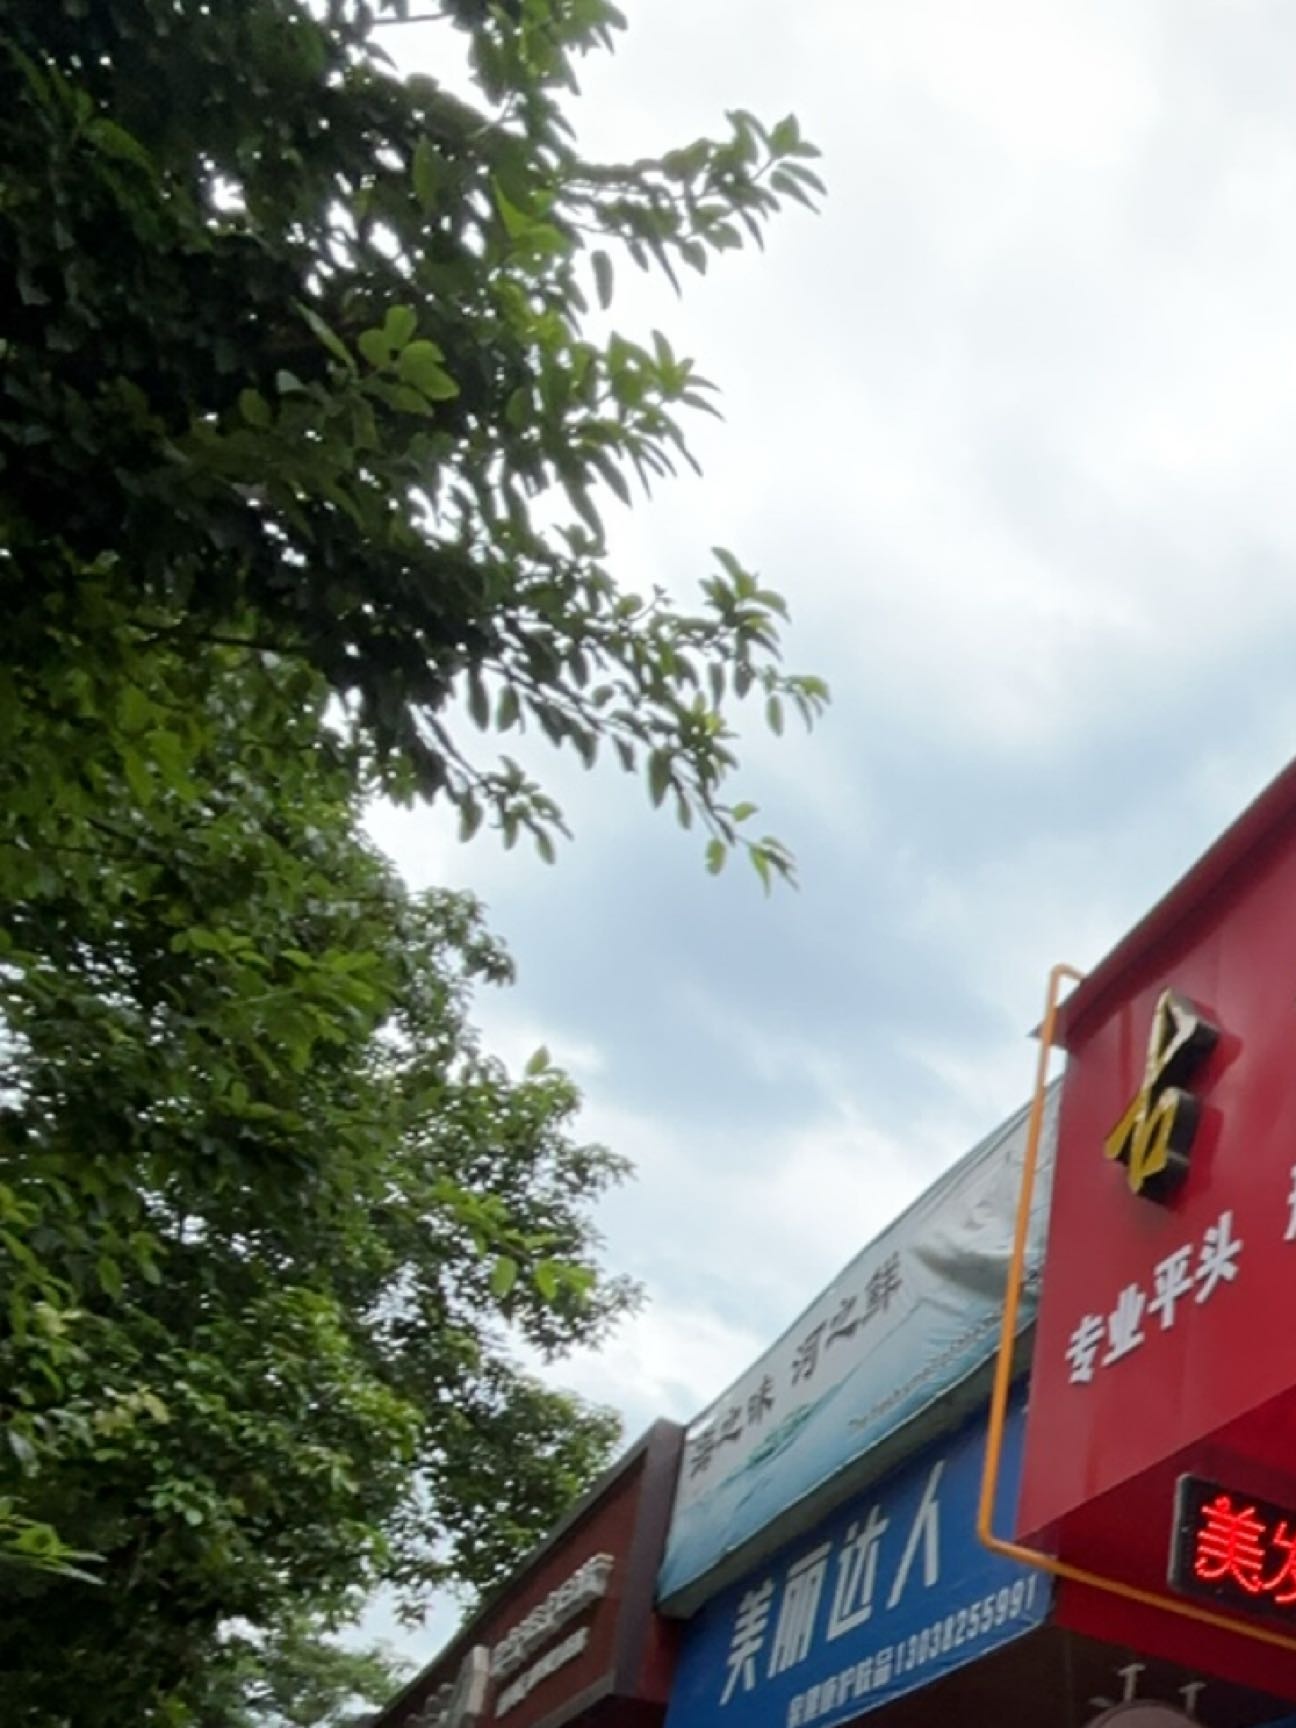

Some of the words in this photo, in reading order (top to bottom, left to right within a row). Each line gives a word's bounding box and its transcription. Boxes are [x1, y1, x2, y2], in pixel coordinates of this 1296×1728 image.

[1065, 1209, 1244, 1385] 专业平头
[720, 1460, 946, 1706] 美丽达人
